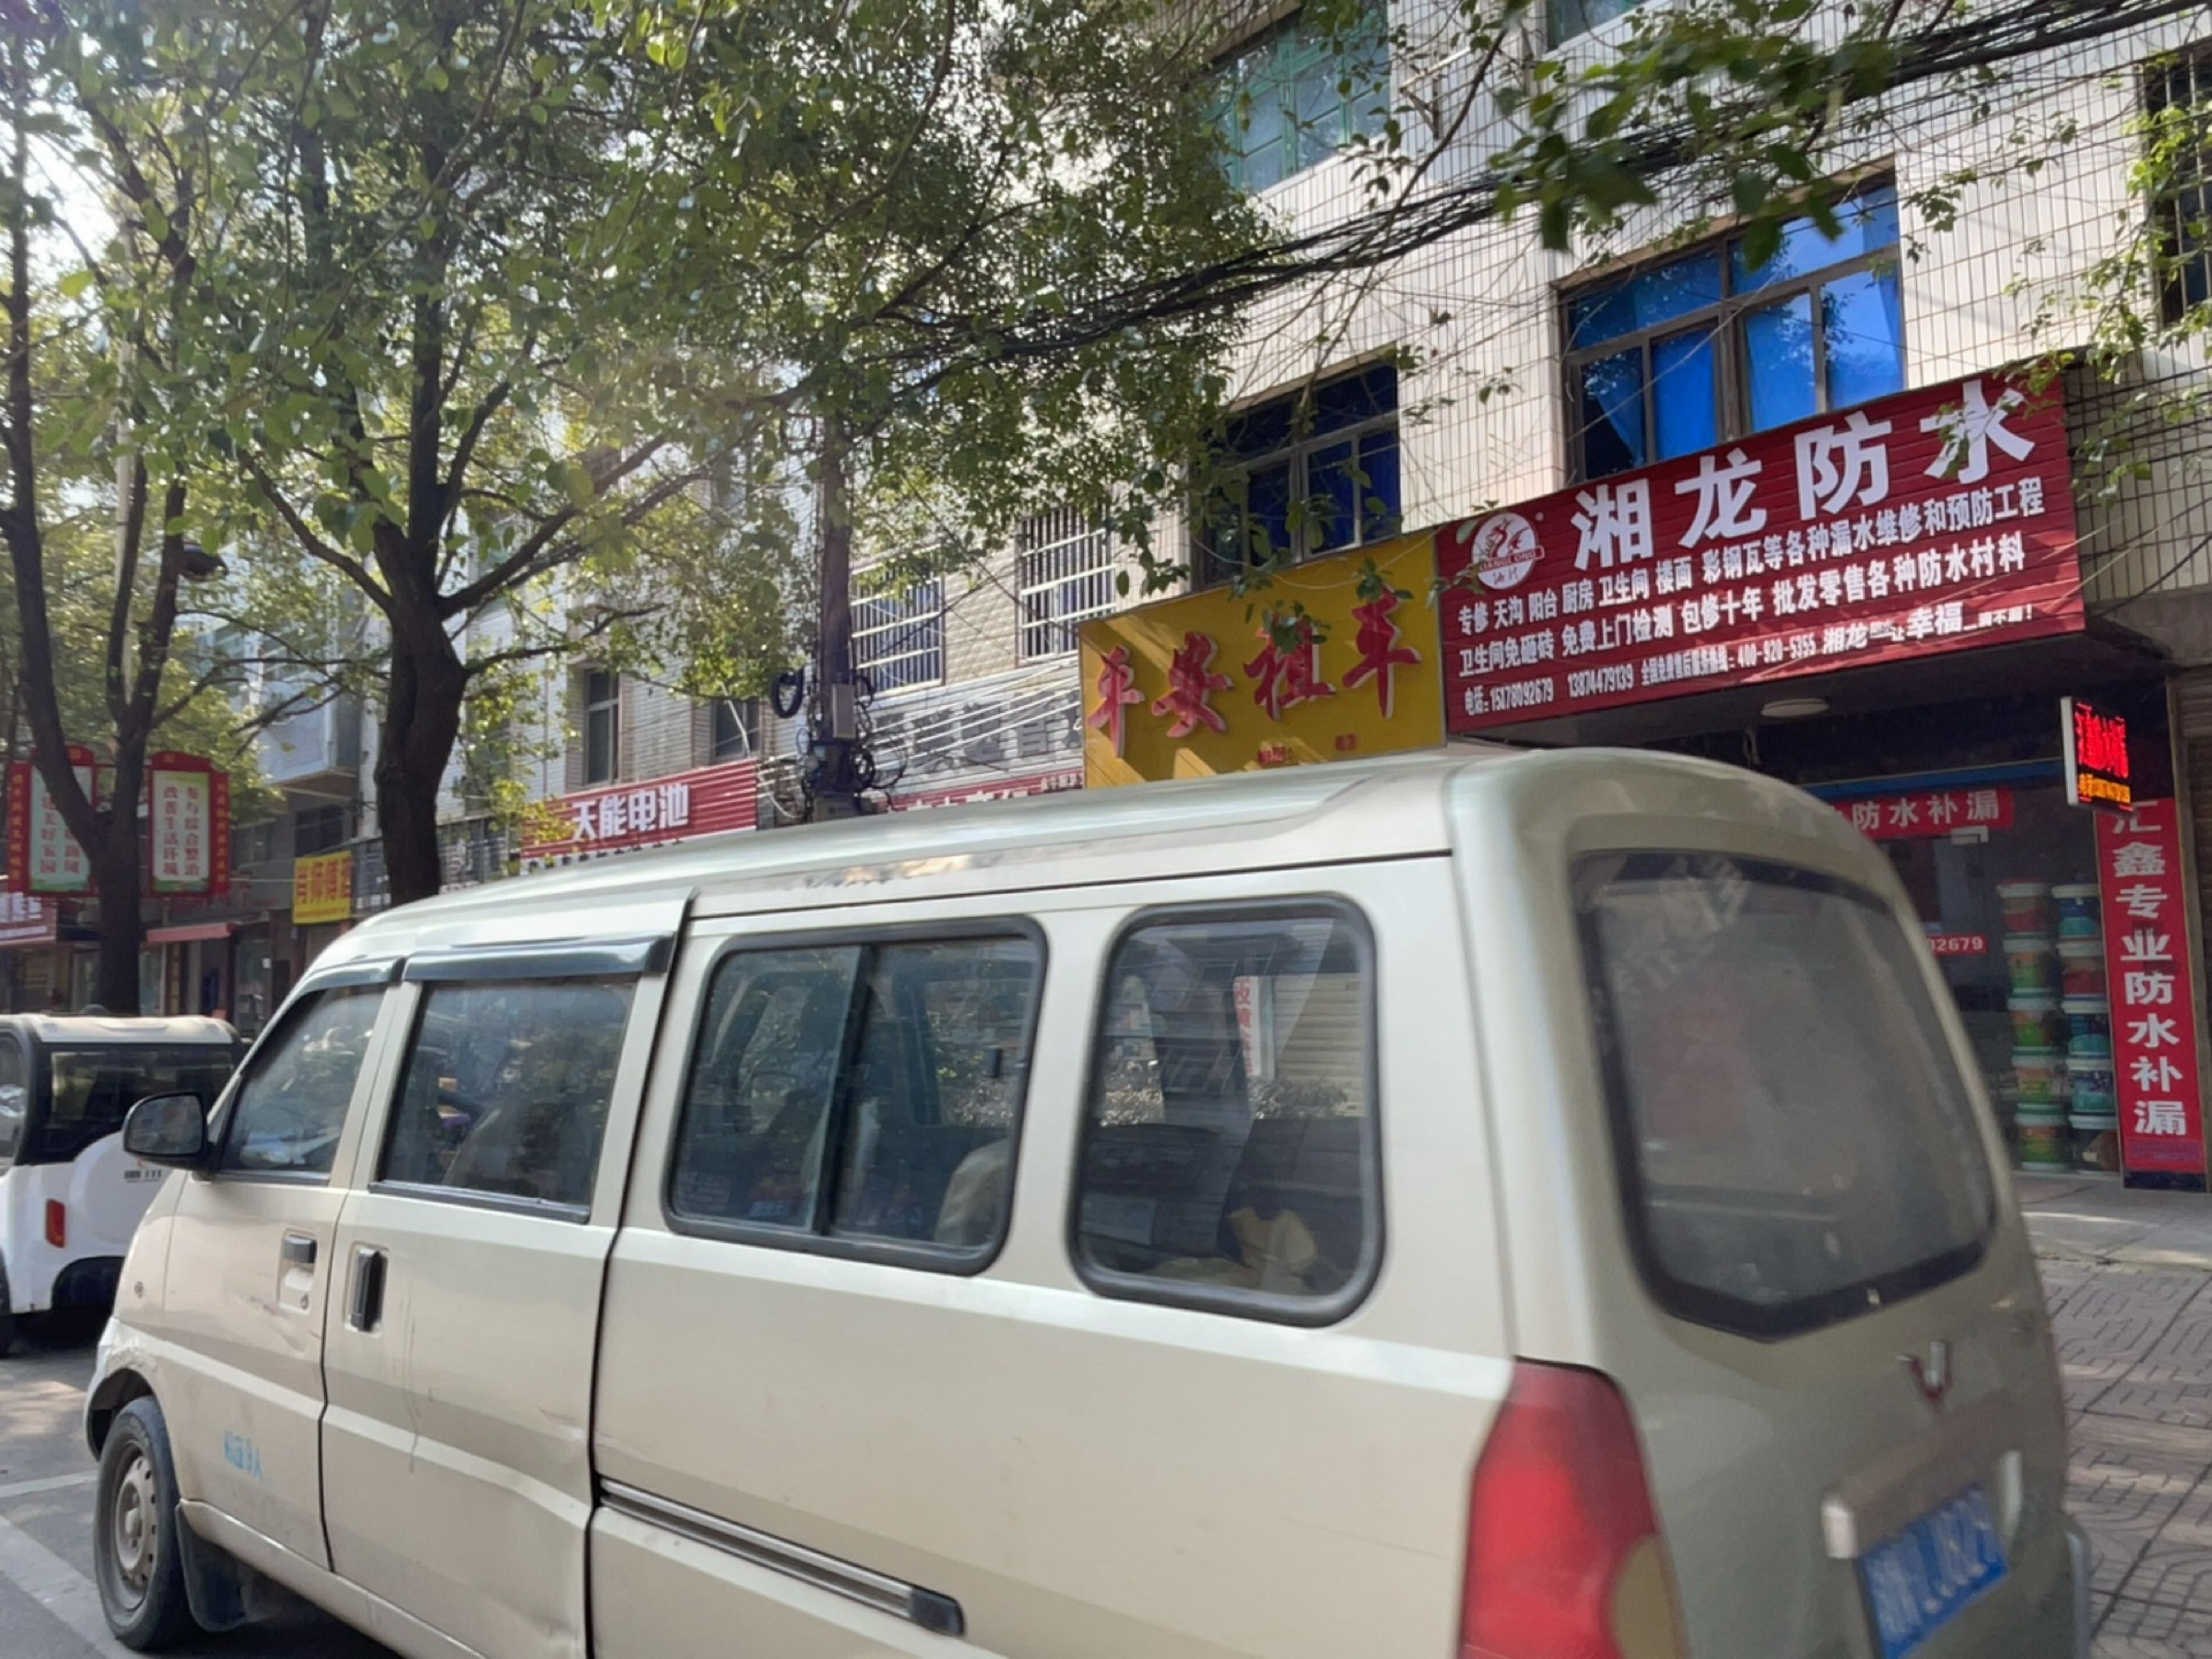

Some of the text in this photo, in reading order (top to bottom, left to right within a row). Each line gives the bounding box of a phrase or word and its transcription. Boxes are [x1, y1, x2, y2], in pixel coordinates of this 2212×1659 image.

[1571, 380, 2035, 570] 湘龙防水
[1599, 568, 1649, 607] 卫生间
[1562, 604, 1674, 657] 免费上门检测
[1681, 586, 1764, 634] 包修十年
[572, 783, 690, 842] 天能电池
[1852, 789, 2000, 830] 防水补漏
